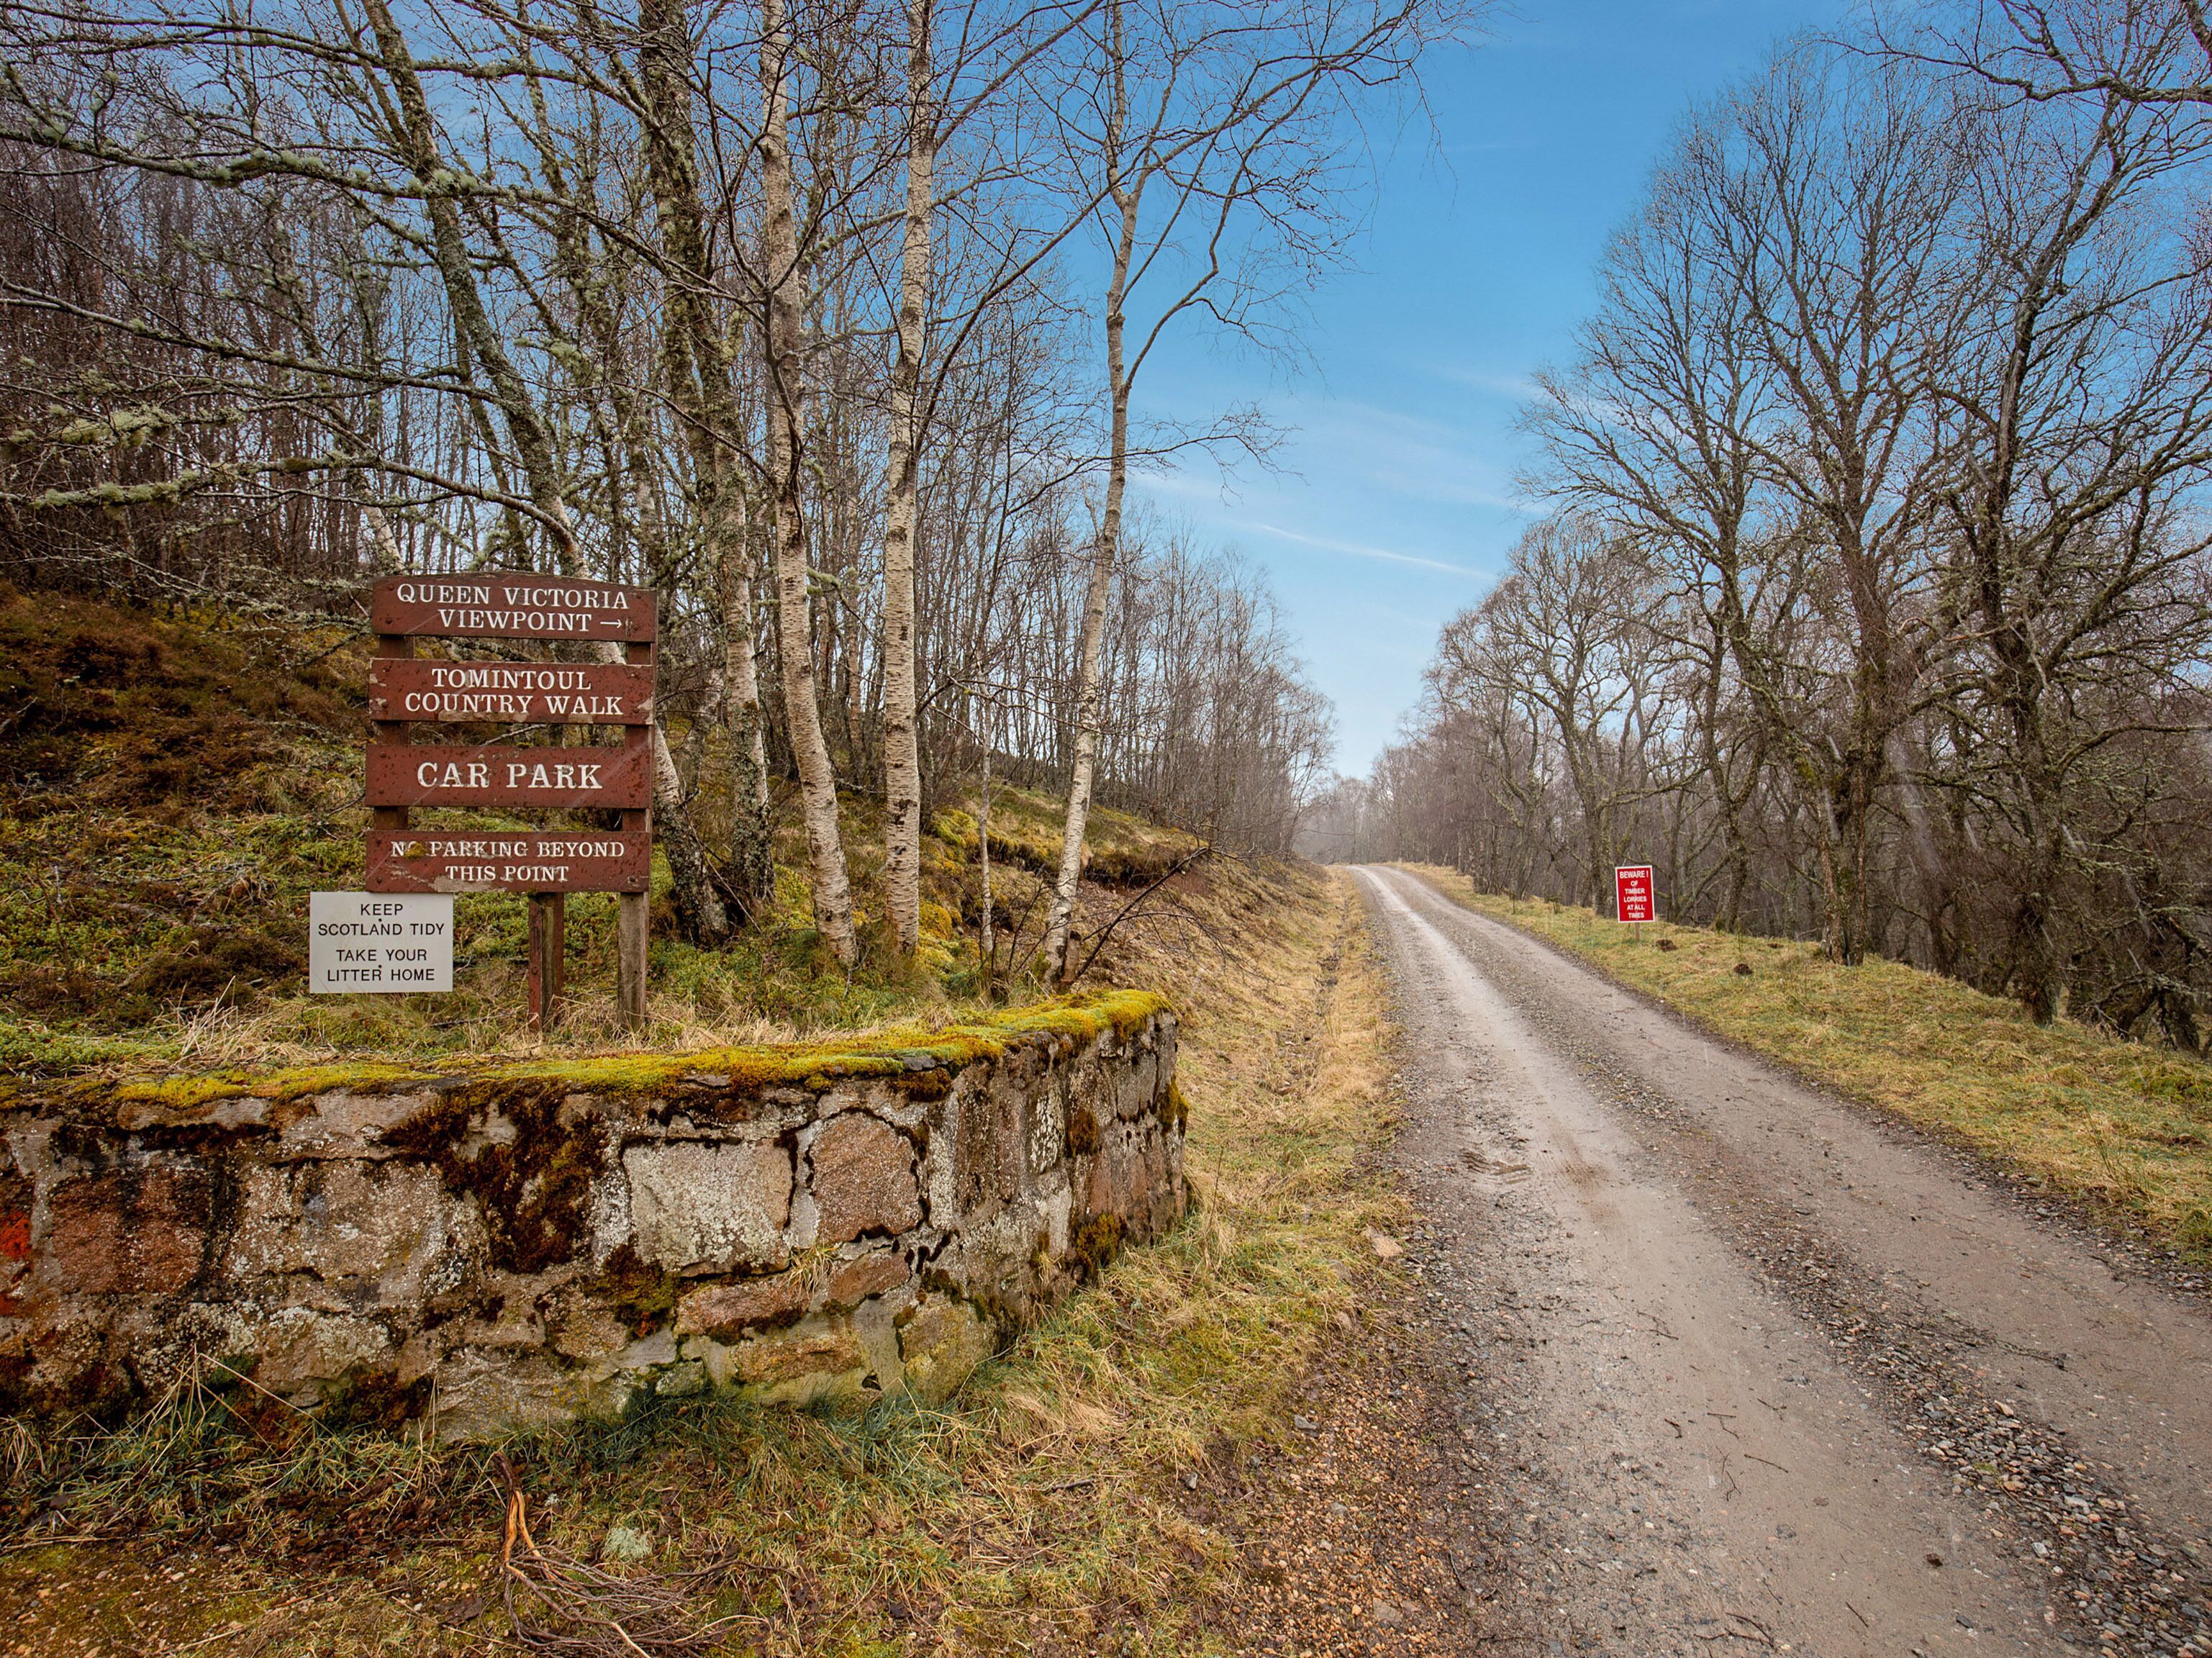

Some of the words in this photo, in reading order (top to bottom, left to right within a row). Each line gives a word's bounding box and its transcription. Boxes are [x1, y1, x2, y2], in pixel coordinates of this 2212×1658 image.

[397, 584, 490, 604] QUEEN
[505, 586, 630, 610] VICTORIA
[439, 609, 592, 632] VIEWPOINT
[432, 668, 592, 691] TOMINTOUL
[404, 693, 533, 714] COUNTRY
[544, 696, 624, 715] WALK
[417, 763, 489, 788] CAR
[507, 764, 603, 789] PARK
[431, 841, 528, 857] PARKING
[538, 842, 625, 857] BEYOND
[445, 866, 497, 881] THIS
[504, 866, 569, 882] POINT
[361, 904, 403, 915] KEEP
[318, 923, 402, 936] SCOTLAND
[410, 923, 445, 936] TIDY
[336, 950, 376, 961] TAKE
[386, 949, 427, 961] YOUR
[327, 969, 381, 982] LITTER
[391, 969, 435, 981] HOME
